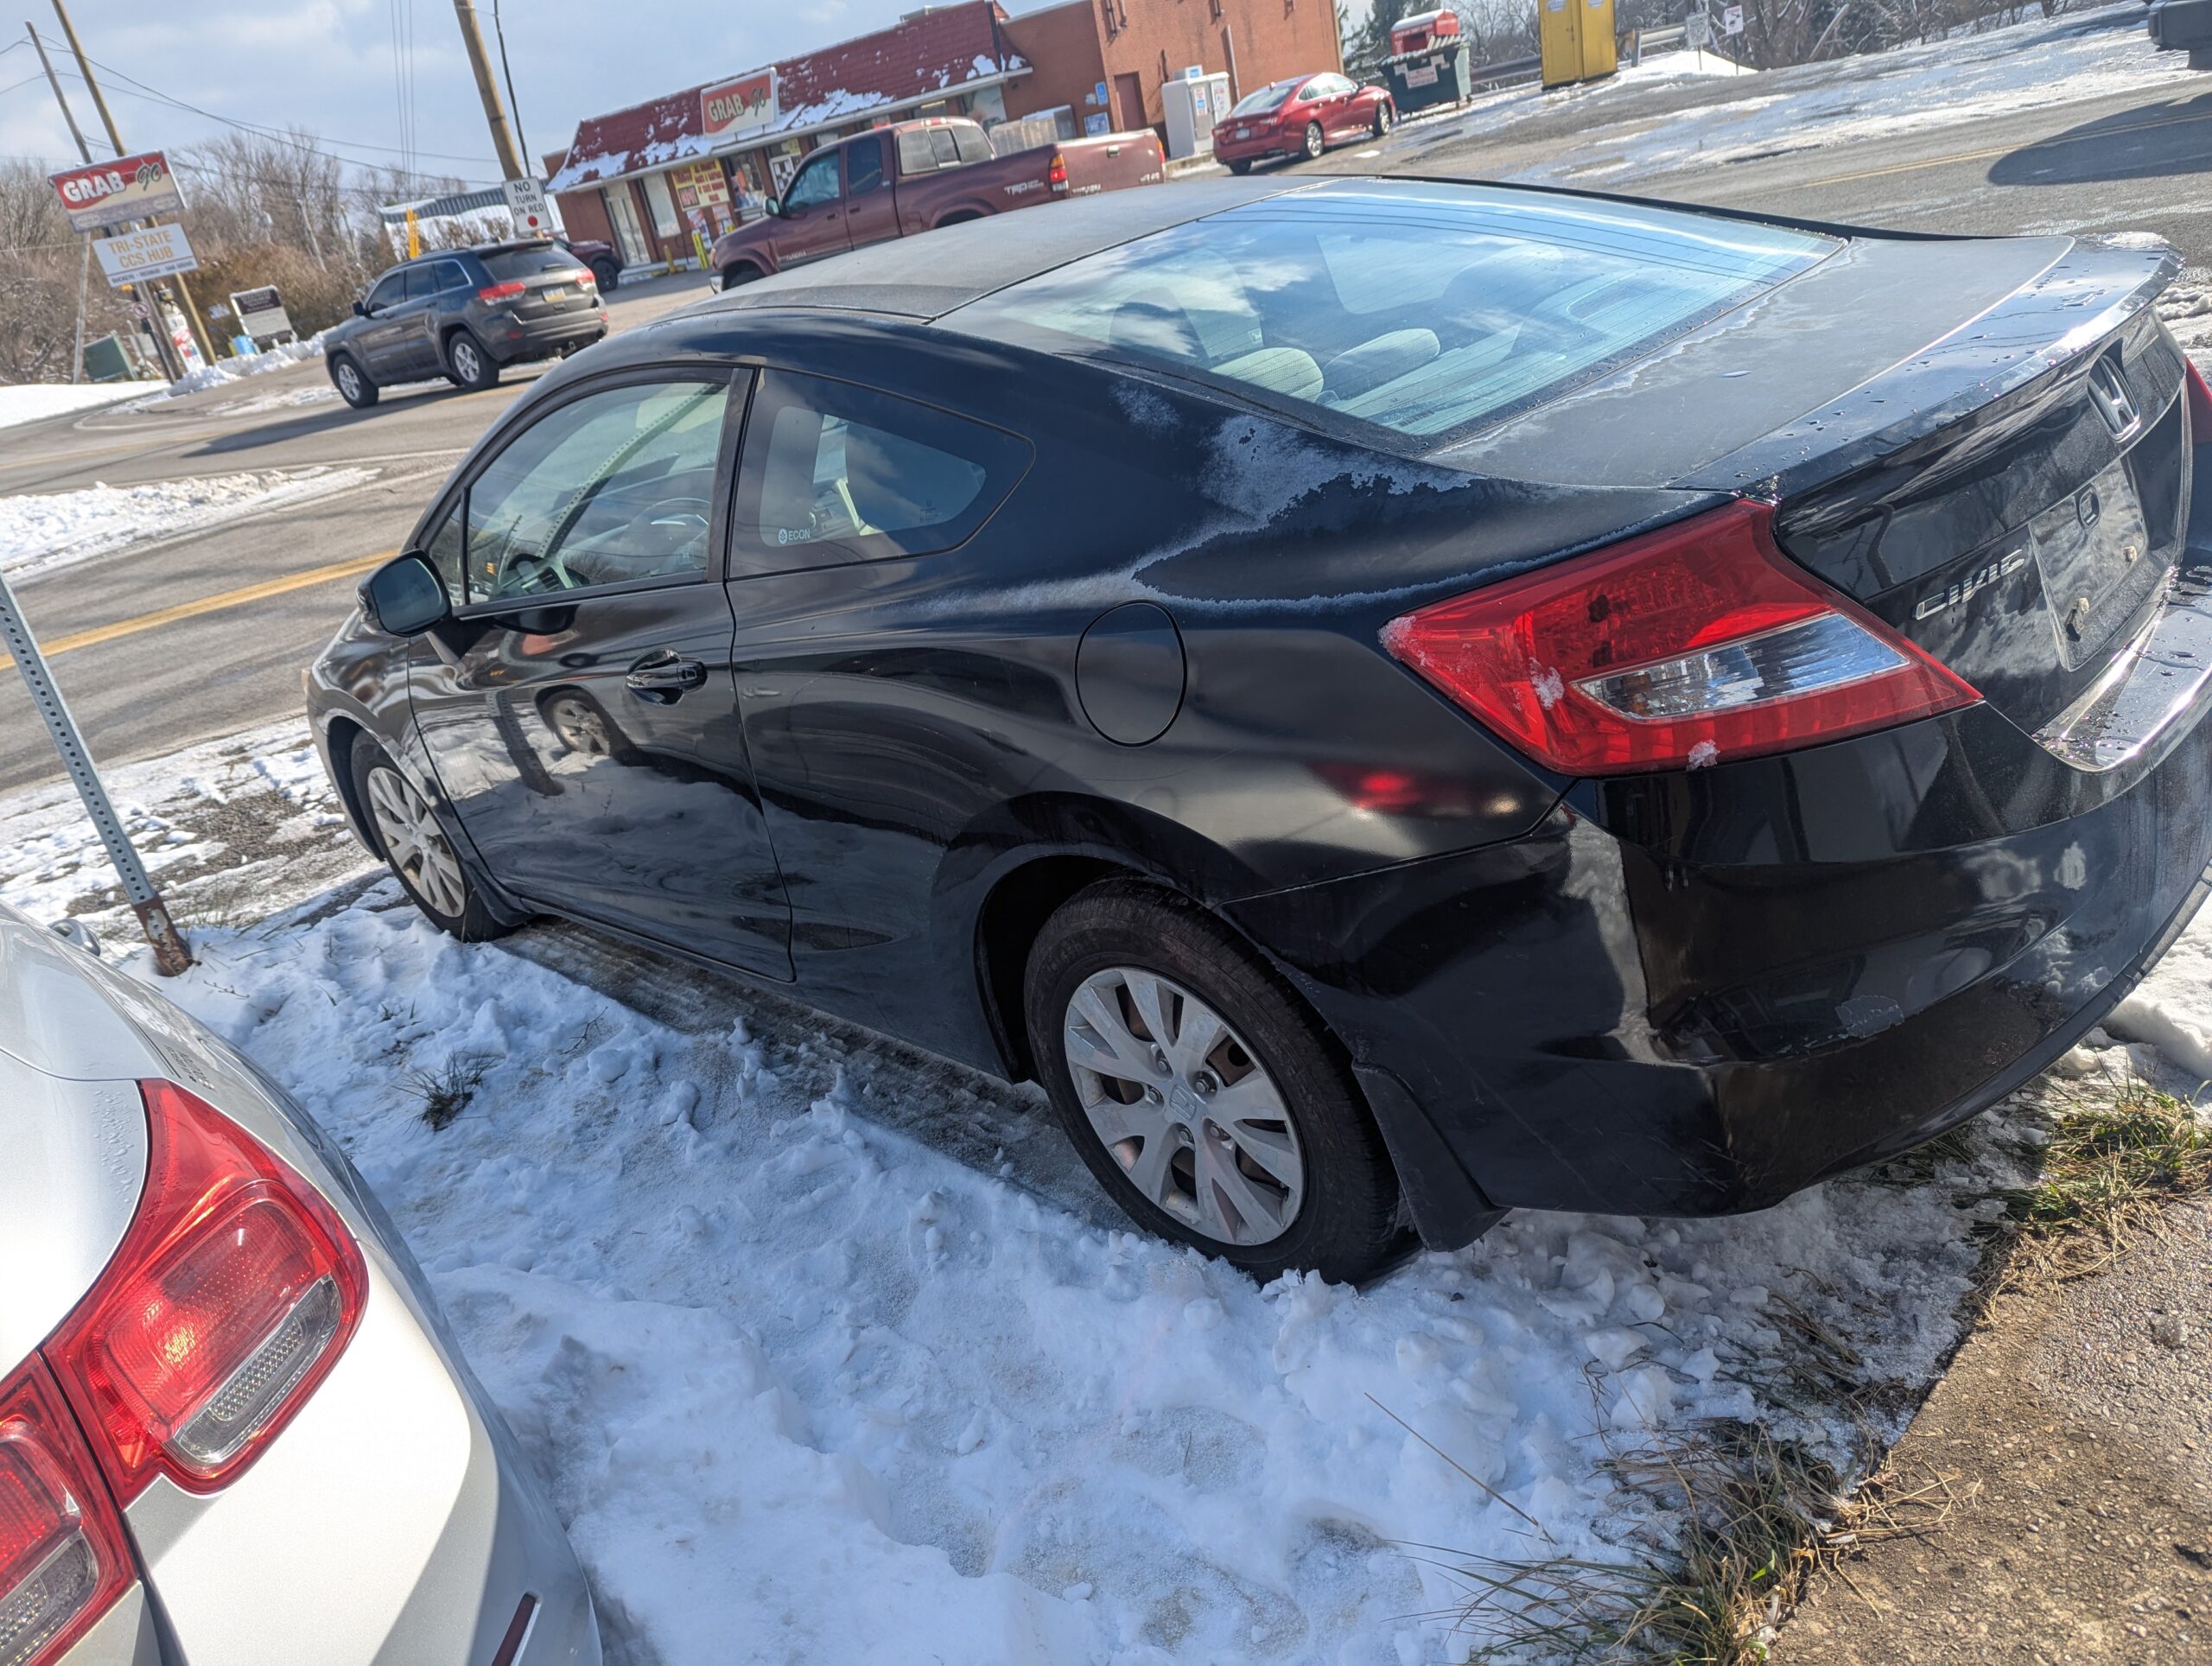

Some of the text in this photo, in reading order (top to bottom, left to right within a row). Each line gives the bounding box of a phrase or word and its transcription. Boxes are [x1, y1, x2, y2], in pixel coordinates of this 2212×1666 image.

[709, 93, 745, 123] GRAB
[63, 172, 126, 202] GRAB
[513, 181, 531, 193] NO
[514, 194, 537, 204] TURN
[514, 203, 544, 216] ON RED
[107, 231, 173, 254] TRI-STATE
[119, 246, 174, 268] CCS HUB
[788, 528, 810, 540] ECON
[1916, 549, 2025, 620] CIVIC
